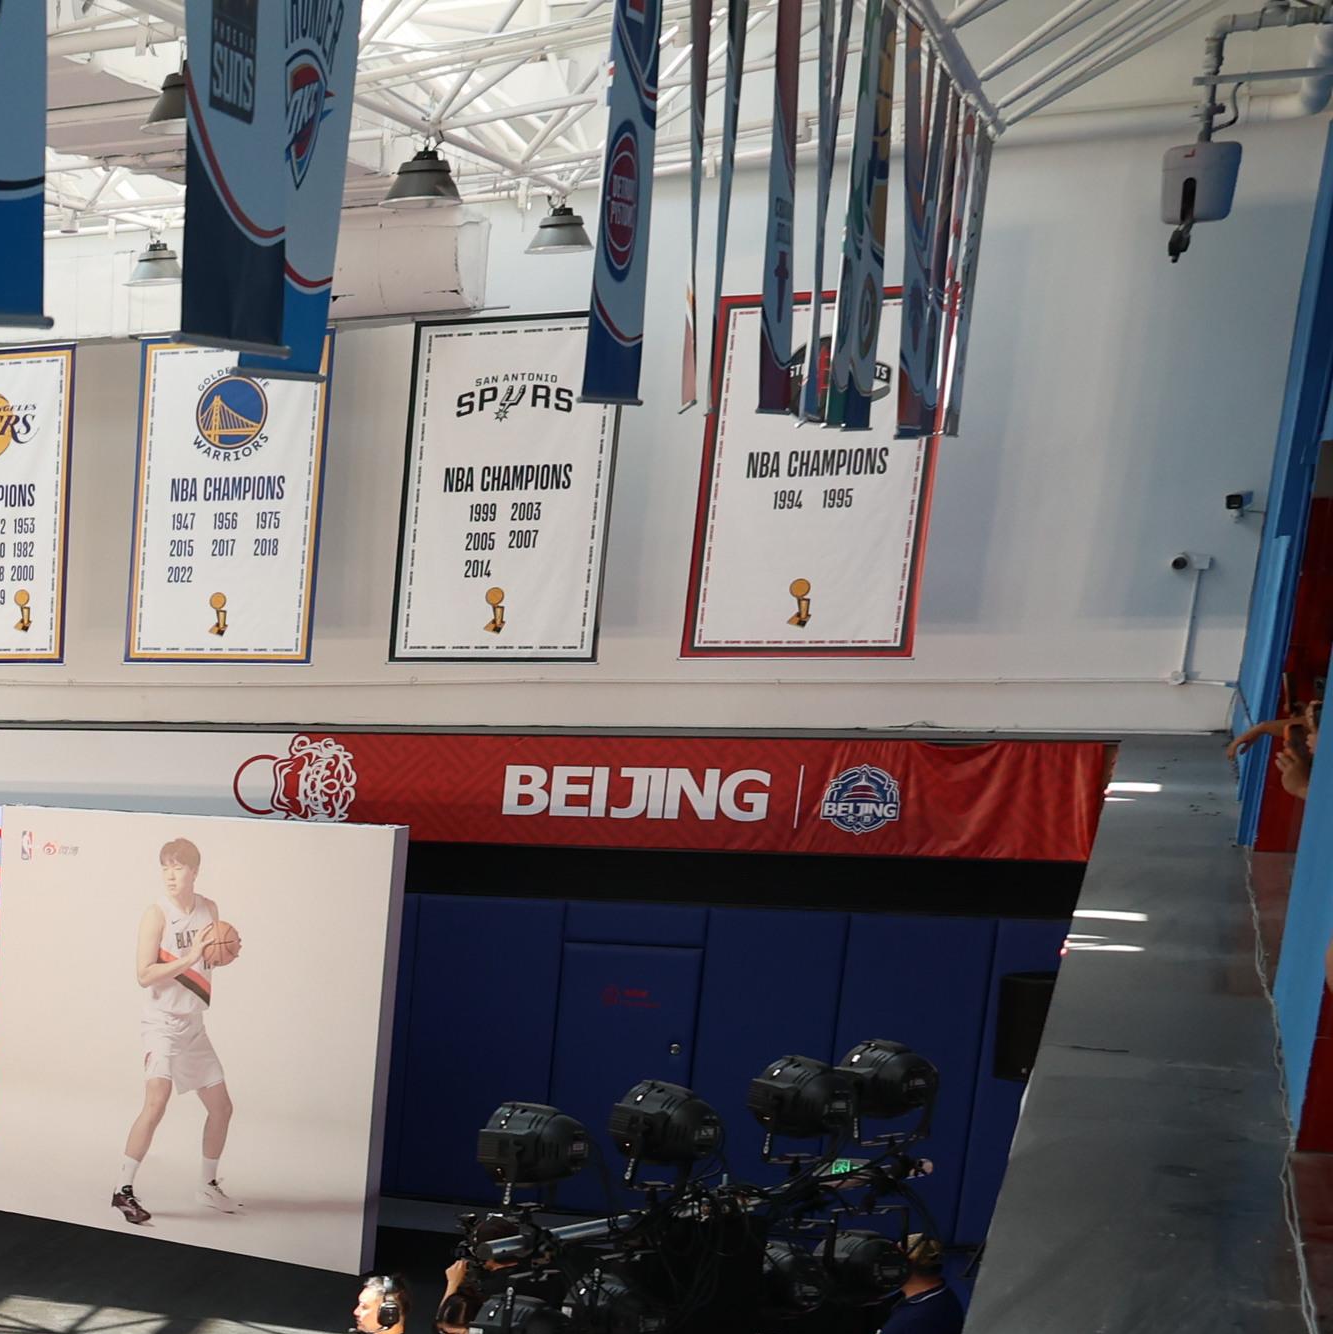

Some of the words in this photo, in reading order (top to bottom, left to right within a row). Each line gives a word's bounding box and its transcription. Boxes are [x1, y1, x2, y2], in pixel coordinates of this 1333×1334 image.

[475, 376, 499, 387] SAN
[502, 372, 559, 385] ANTONIO
[455, 383, 574, 421] SPURS
[193, 433, 269, 462] WARRIORS
[746, 450, 780, 479] NBA
[786, 448, 889, 477] CHAMPIONS
[443, 466, 476, 493] NBA
[480, 464, 573, 492] CHAMPIONS
[170, 477, 198, 503] NBA
[203, 475, 286, 502] CHAMPIONS
[773, 490, 803, 510] 1994
[822, 488, 854, 508] 1995
[171, 513, 196, 530] 1947
[212, 512, 238, 530] 1956
[256, 511, 281, 529] 1975
[469, 503, 497, 522] 1999
[510, 501, 542, 521] 2003
[13, 517, 35, 535] 1953
[12, 541, 35, 558] 1982
[169, 539, 194, 557] 2015
[211, 539, 236, 557] 2017
[253, 538, 279, 556] 2018
[465, 532, 496, 551] 2005
[508, 529, 539, 549] 2007
[10, 564, 34, 582] 2000
[167, 566, 193, 583] 2022
[463, 559, 492, 578] 2014
[501, 764, 772, 823] BEIJING
[823, 802, 897, 818] BEIJING
